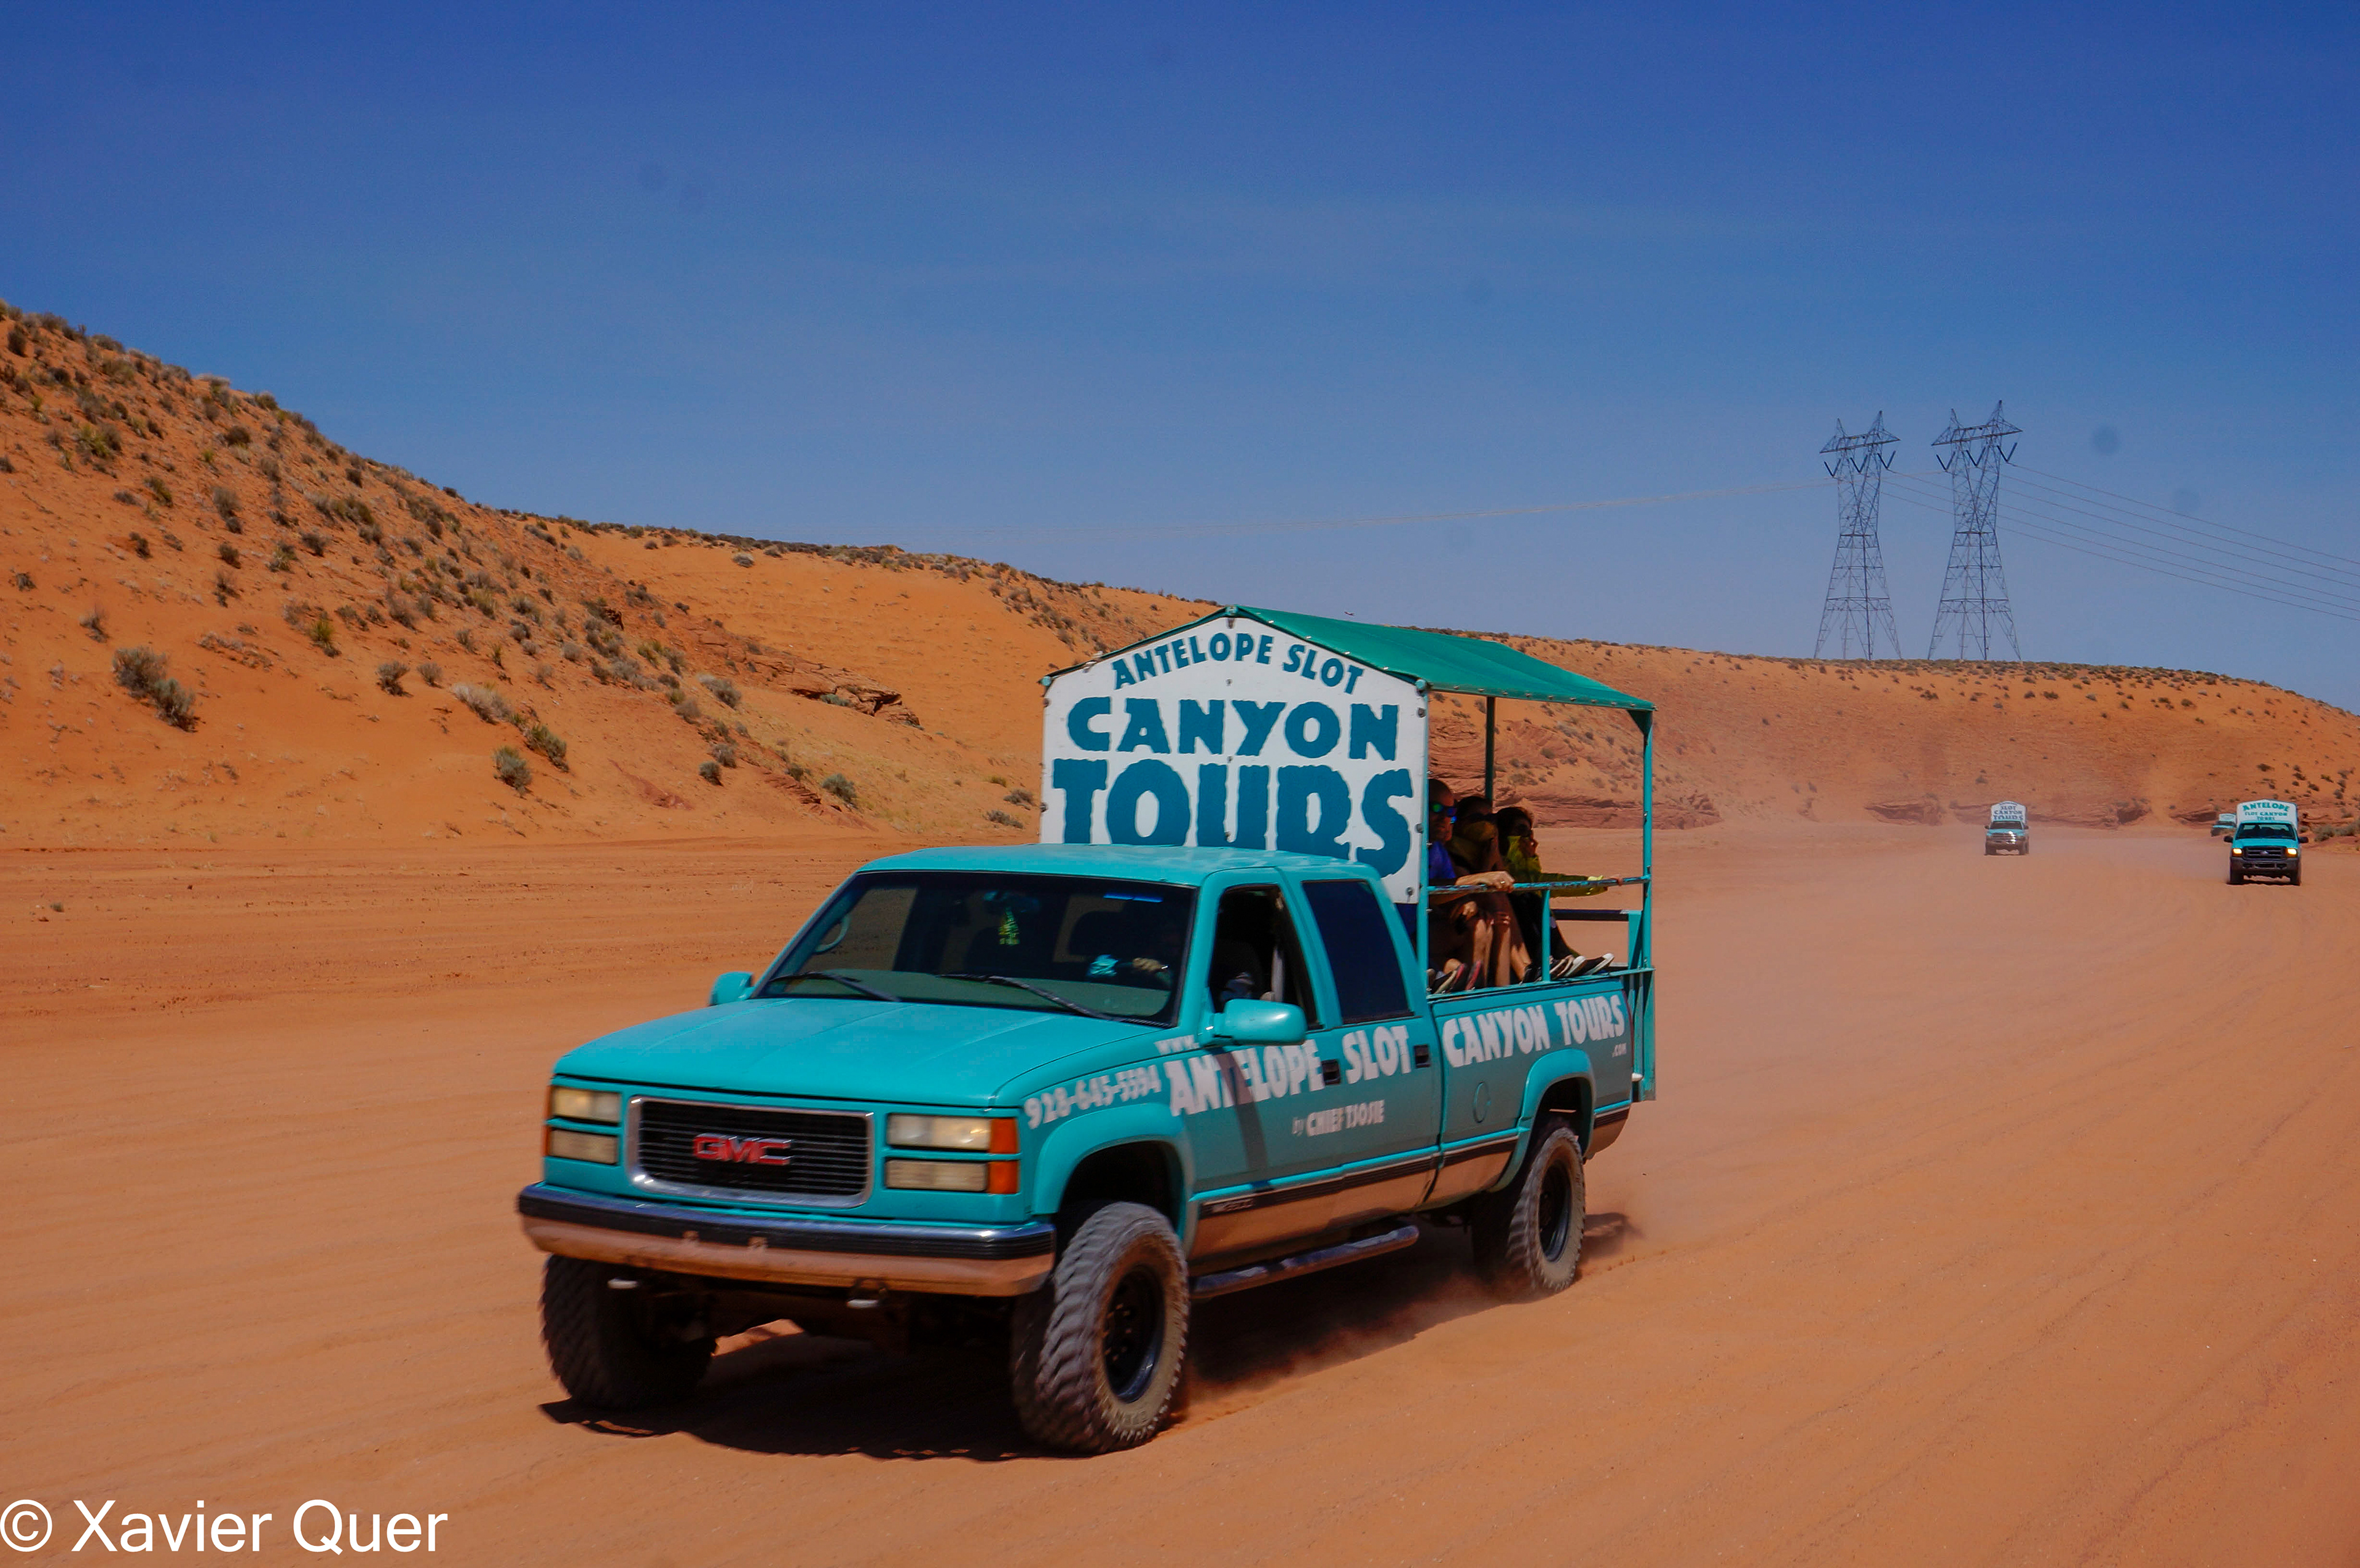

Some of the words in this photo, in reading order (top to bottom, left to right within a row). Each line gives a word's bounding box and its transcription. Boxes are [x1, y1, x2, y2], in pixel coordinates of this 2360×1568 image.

[1112, 633, 1274, 691] ANTELOPE
[1283, 644, 1364, 696] SLOT
[1067, 696, 1399, 761] CANYON
[1052, 758, 1414, 879] TOURS
[2243, 802, 2290, 812] ANTELOPE
[1163, 1039, 1325, 1117] ANTELOPE
[1342, 1025, 1411, 1084] SLOT
[1442, 1004, 1551, 1068] CANYON
[1554, 995, 1626, 1045] TOURS
[692, 1132, 795, 1166] GMC
